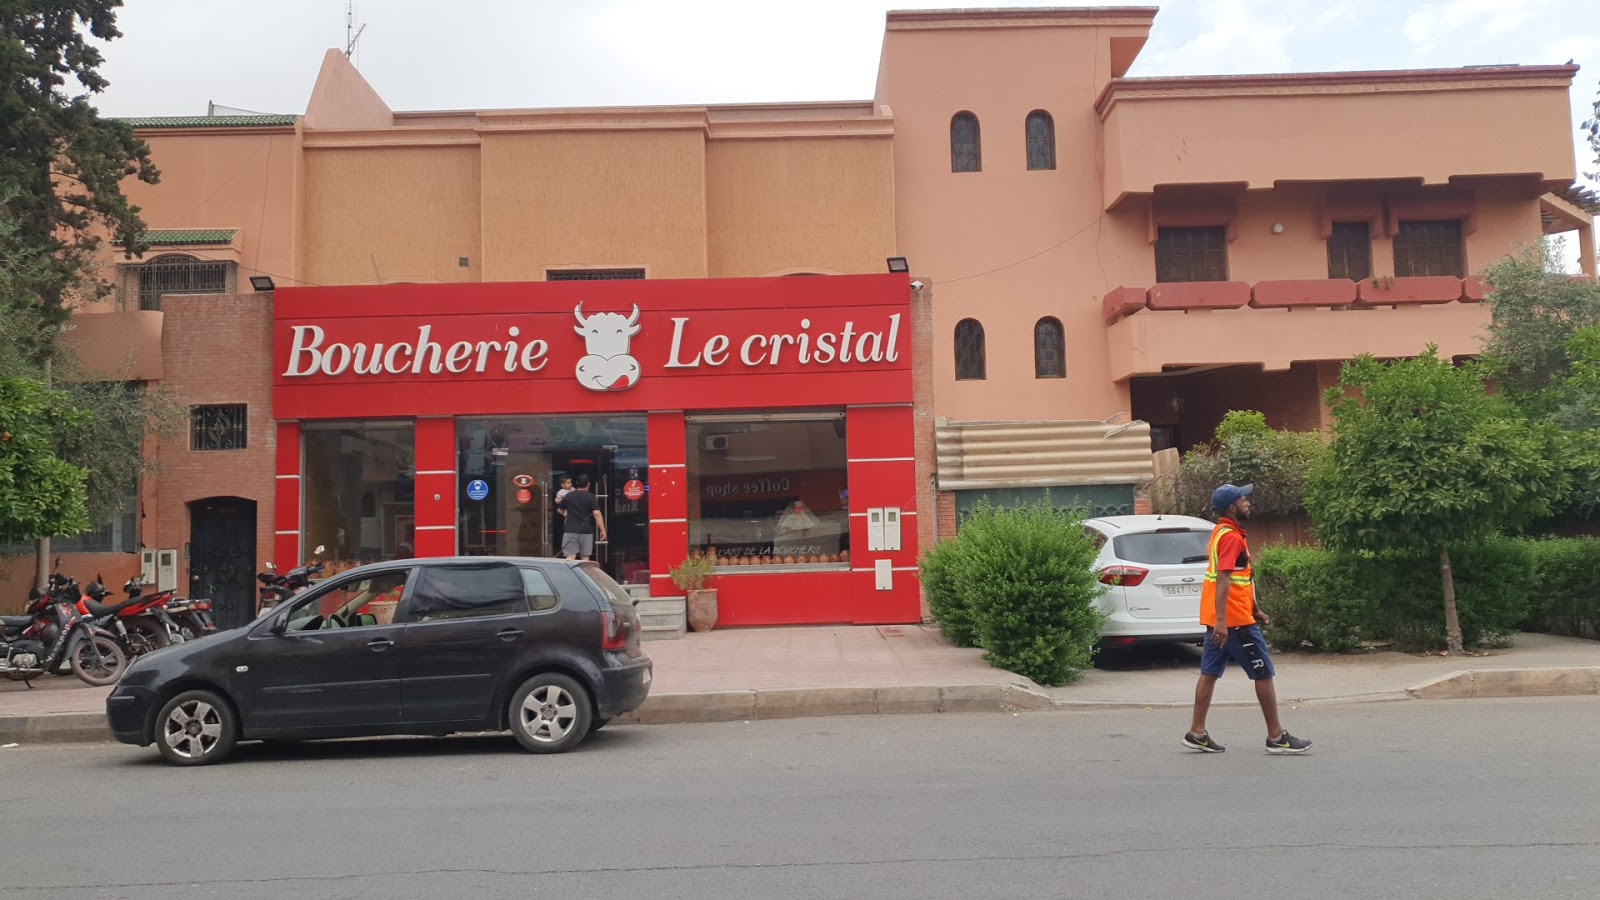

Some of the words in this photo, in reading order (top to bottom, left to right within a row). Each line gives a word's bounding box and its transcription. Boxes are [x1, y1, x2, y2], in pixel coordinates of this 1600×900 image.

[282, 325, 548, 377] Boucherie
[664, 317, 730, 368] Le
[740, 313, 900, 366] cristal
[717, 547, 743, 557] L'ART
[744, 546, 757, 556] DE
[760, 546, 771, 555] LA
[772, 545, 822, 555] BOUCHERIE
